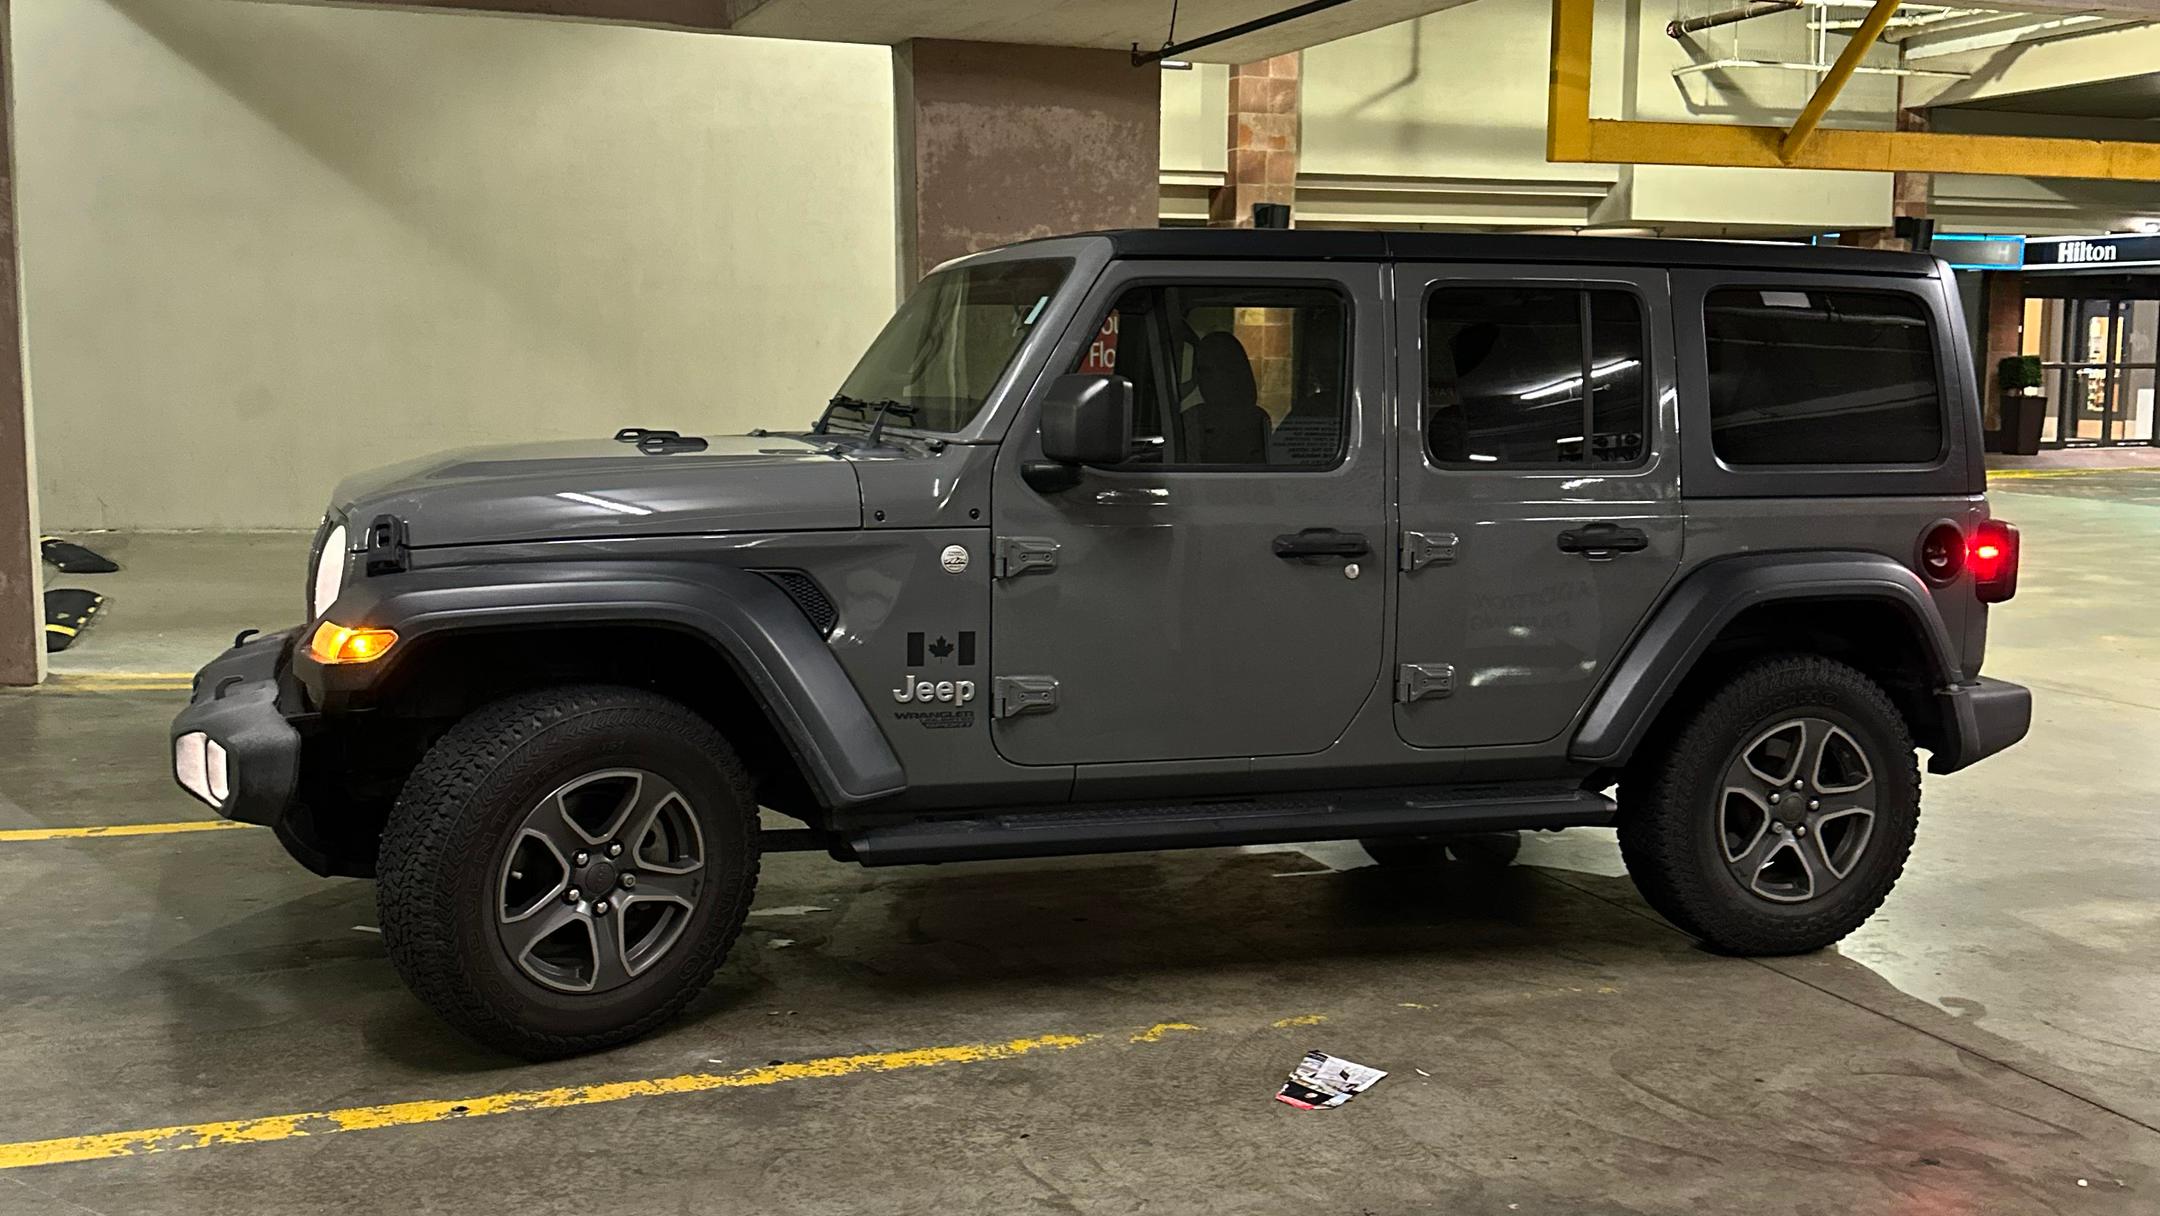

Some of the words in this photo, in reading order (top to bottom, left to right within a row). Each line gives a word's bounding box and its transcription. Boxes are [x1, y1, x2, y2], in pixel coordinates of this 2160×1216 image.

[2057, 241, 2117, 263] Hilton
[893, 675, 975, 706] Jeep
[894, 711, 975, 720] WRANGLER
